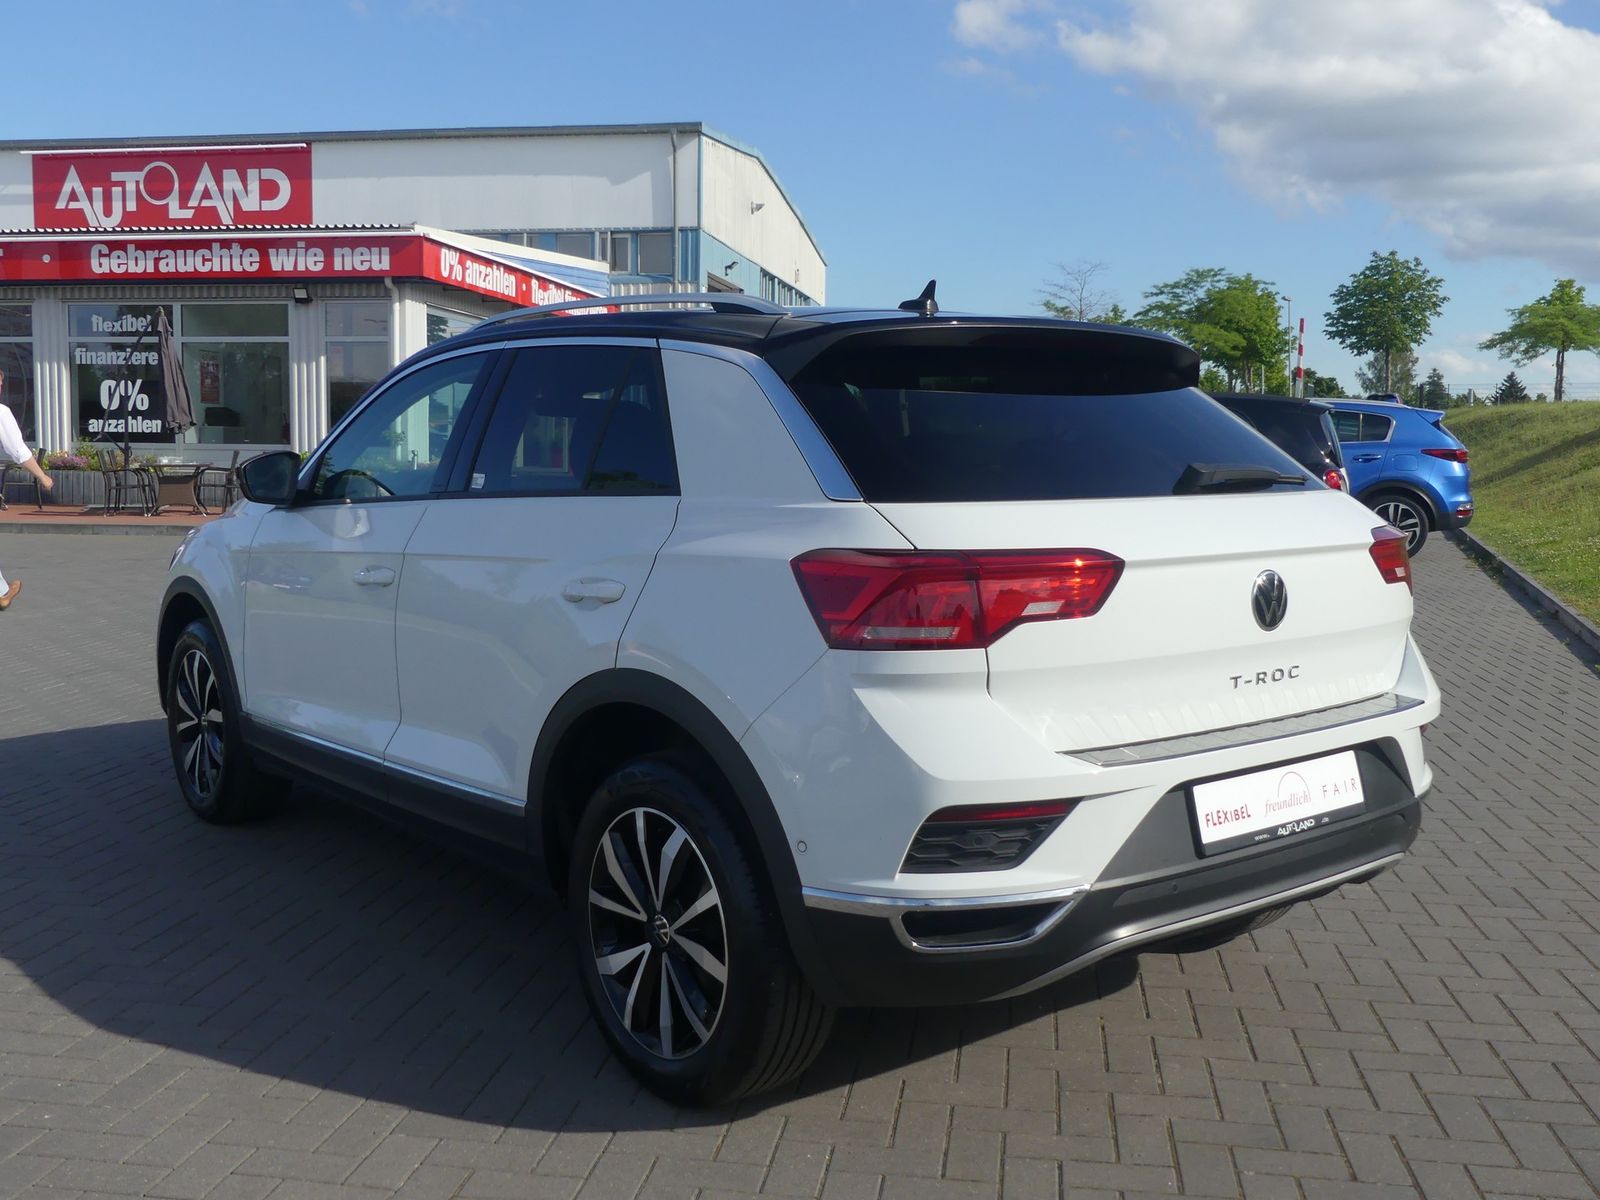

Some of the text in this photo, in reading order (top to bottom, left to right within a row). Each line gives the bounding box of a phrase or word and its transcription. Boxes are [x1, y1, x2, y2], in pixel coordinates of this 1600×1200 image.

[55, 161, 292, 228] AUTOLAND
[90, 241, 390, 274] Gebrauchte wie neu
[440, 248, 463, 282] 0%
[465, 261, 516, 297] anzahlen
[100, 379, 149, 411] 0%
[88, 416, 162, 433] anzahlen
[1229, 665, 1300, 689] T-ROC
[1205, 804, 1251, 828] FLEXIBEL
[1264, 790, 1312, 817] freundlich
[1277, 819, 1315, 835] AUTOLAND
